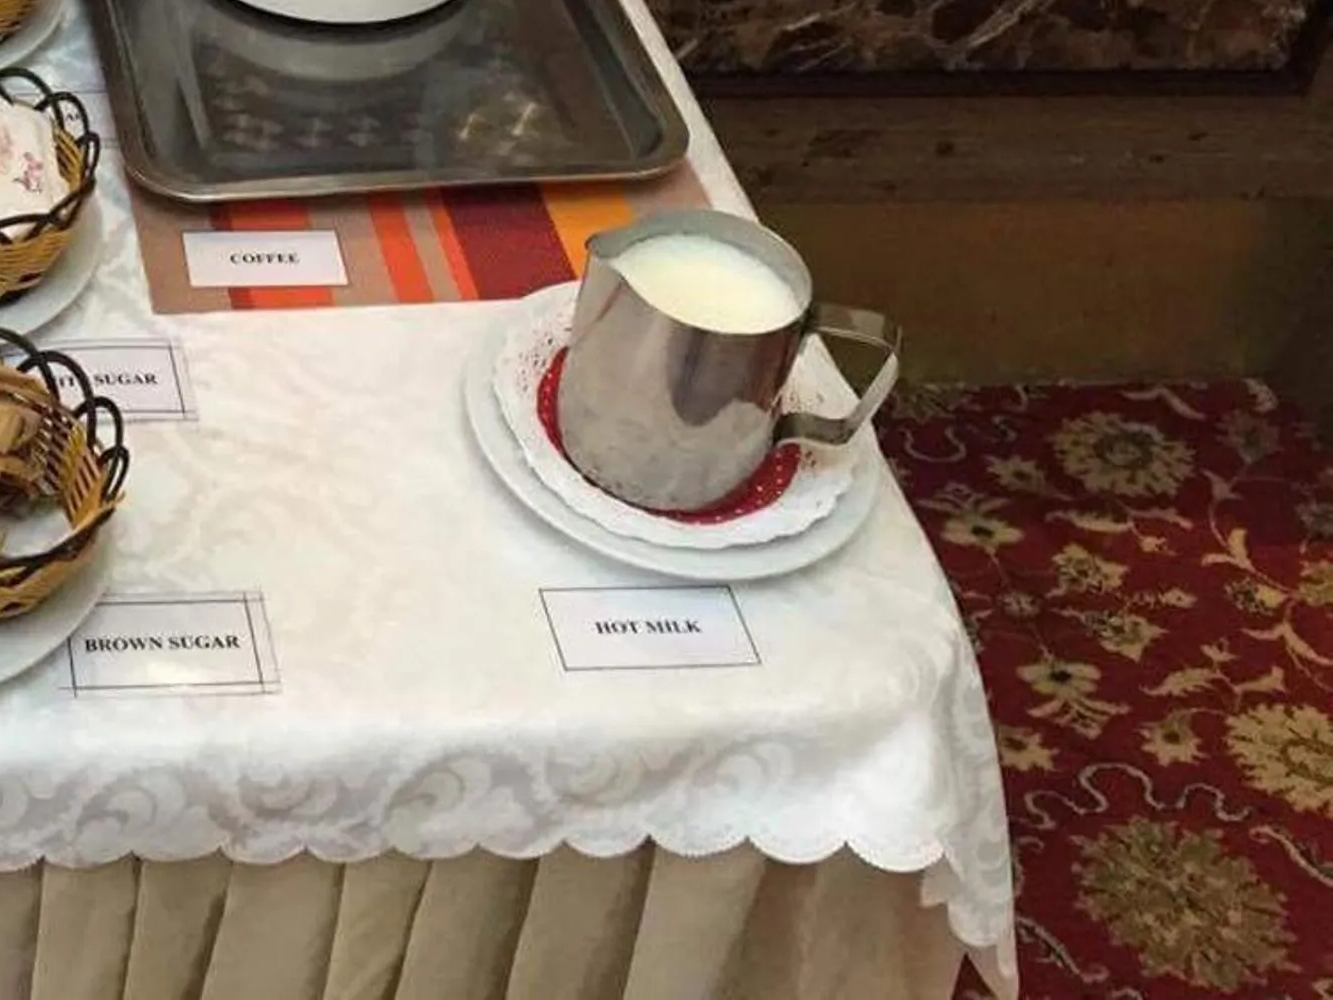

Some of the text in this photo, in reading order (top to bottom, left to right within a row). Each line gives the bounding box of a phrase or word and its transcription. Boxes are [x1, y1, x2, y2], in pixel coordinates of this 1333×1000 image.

[229, 252, 301, 265] COFFEE
[93, 372, 158, 386] SUGAR
[595, 618, 703, 635] HOT MILK
[84, 634, 241, 653] BROWN SUGAR
